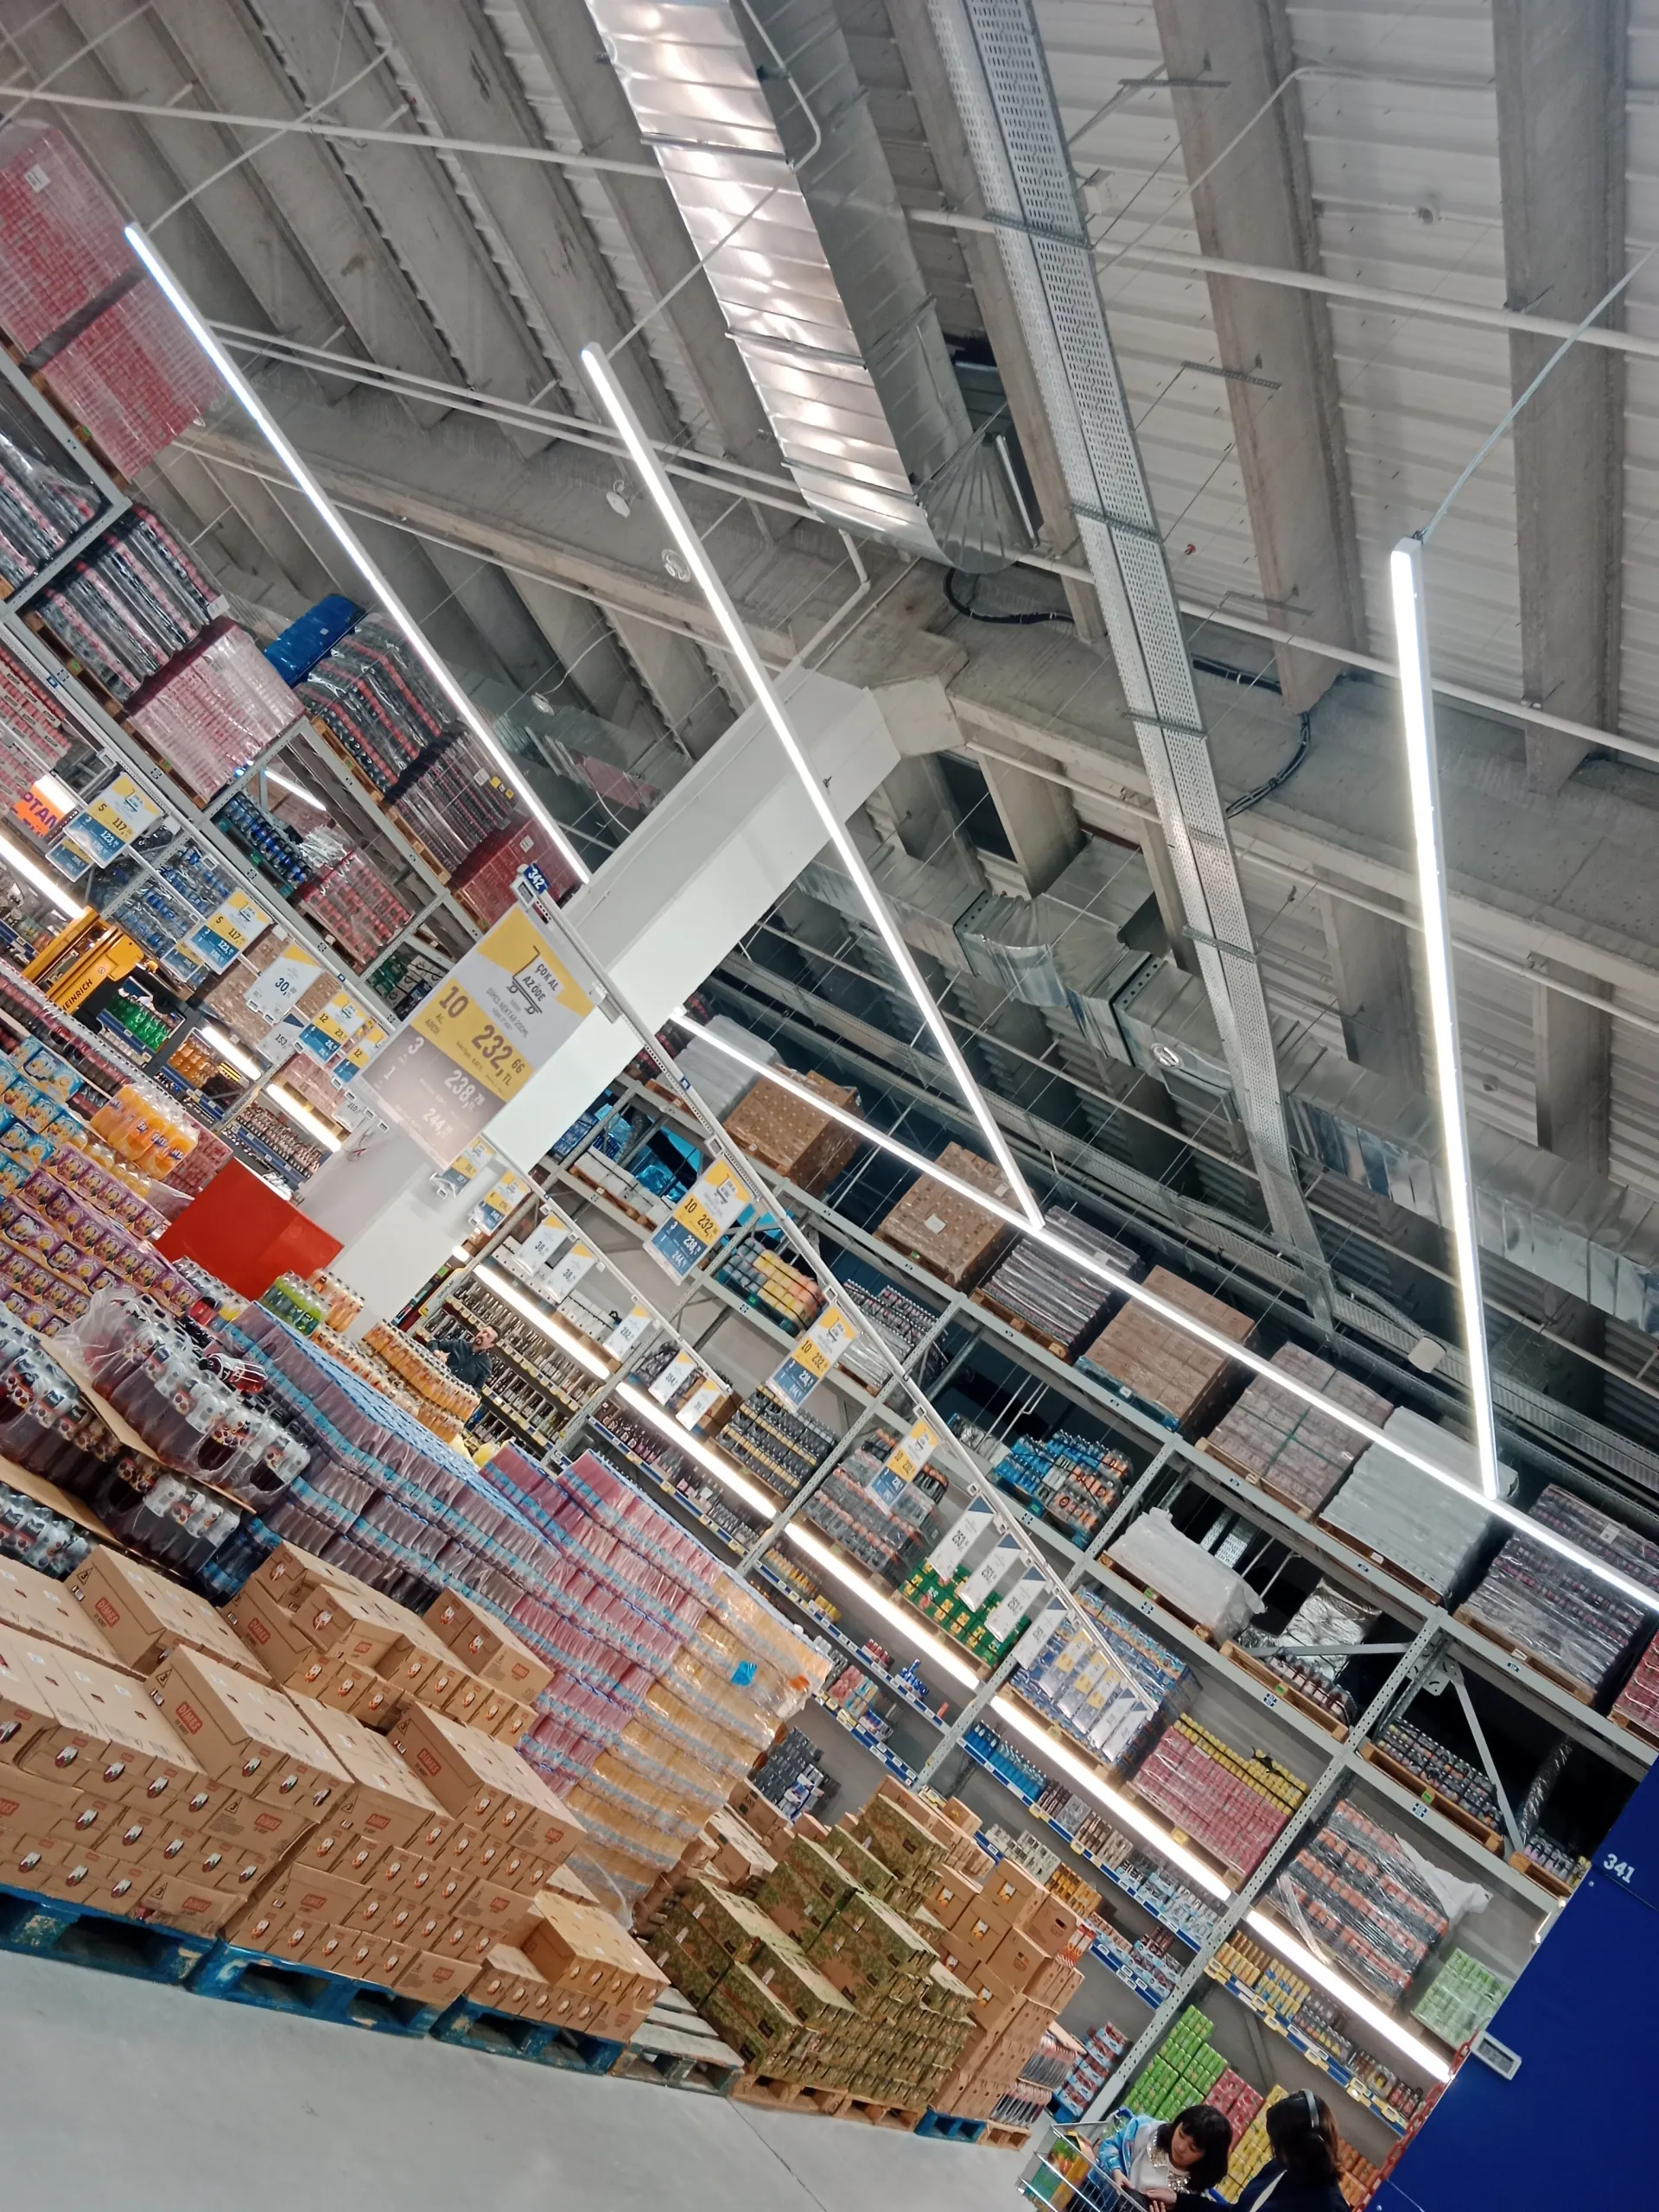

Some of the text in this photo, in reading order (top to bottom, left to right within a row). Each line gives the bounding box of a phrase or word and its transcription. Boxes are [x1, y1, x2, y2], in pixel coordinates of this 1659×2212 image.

[97, 803, 106, 813] 5
[526, 867, 546, 890] 342
[214, 915, 223, 925] 5
[522, 976, 535, 988] AZ
[535, 963, 558, 990] ÇOK AL
[438, 985, 470, 1020] 10
[318, 1014, 328, 1023] 12
[498, 1001, 517, 1022] NEKTAR
[353, 1048, 362, 1058] 12
[405, 1034, 426, 1056] 3
[510, 1058, 525, 1074] 66
[502, 1072, 513, 1085] TL
[683, 1198, 698, 1214] 10
[800, 1339, 813, 1354] 10
[1602, 1852, 1635, 1884] 341
